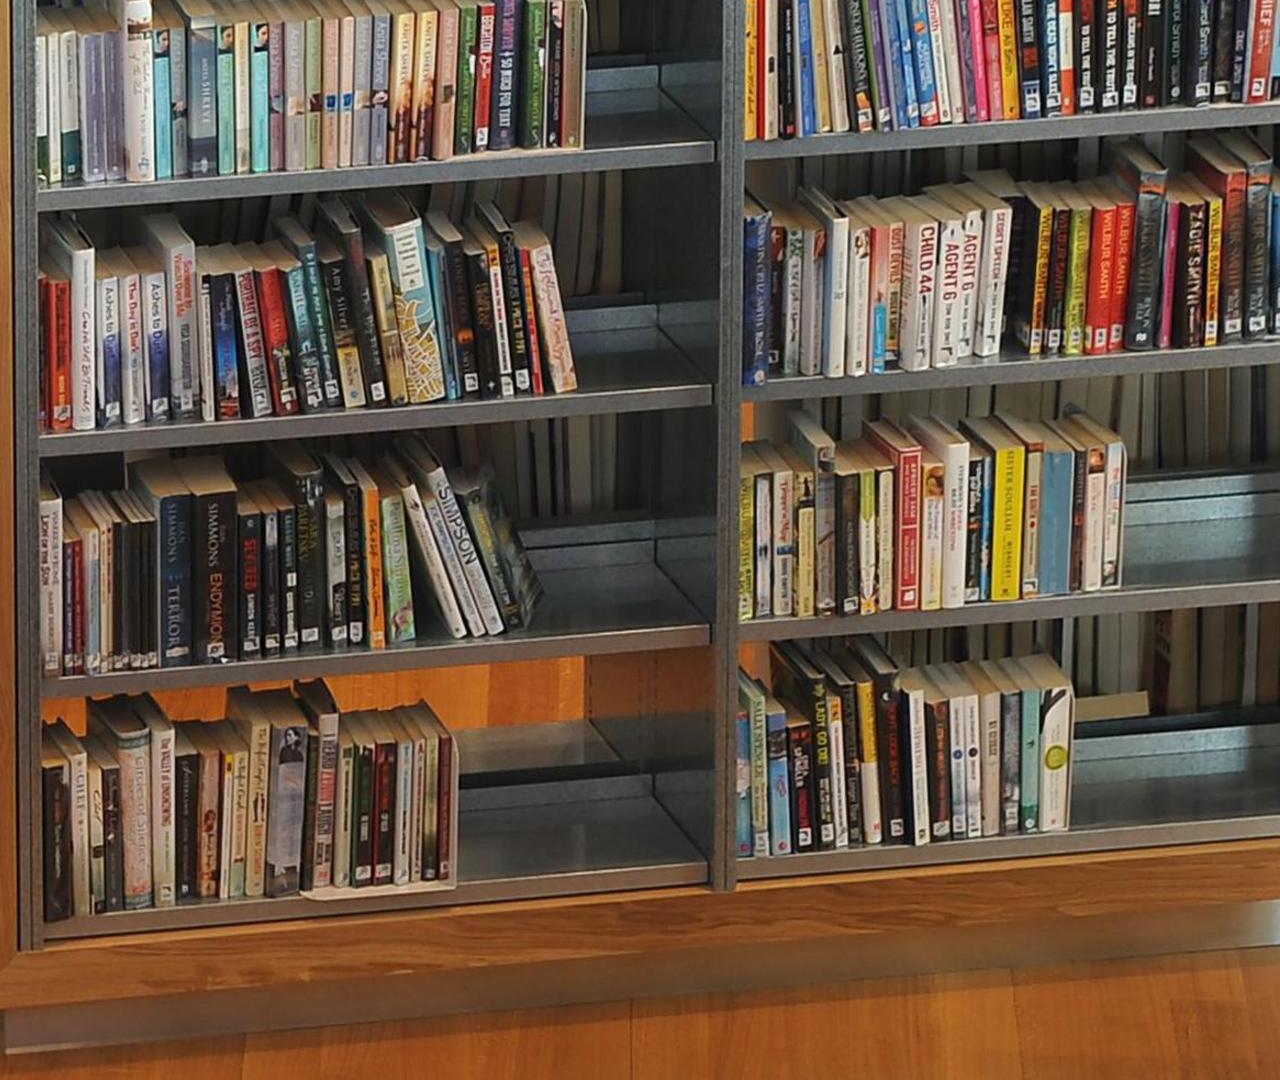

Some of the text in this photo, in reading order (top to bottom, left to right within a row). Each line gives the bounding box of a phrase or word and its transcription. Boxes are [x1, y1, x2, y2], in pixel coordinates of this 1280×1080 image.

[200, 81, 212, 125] SHREVE
[919, 227, 936, 295] CHILD 44
[962, 234, 978, 291] AGENT 6
[1114, 207, 1132, 295] WILBUR SMITH
[151, 283, 162, 320] Ashes
[152, 321, 162, 330] to
[207, 503, 223, 567] SIMMONS
[438, 488, 477, 566] SIMPSON
[167, 586, 182, 646] TERROR
[209, 573, 225, 643] ENDYMION
